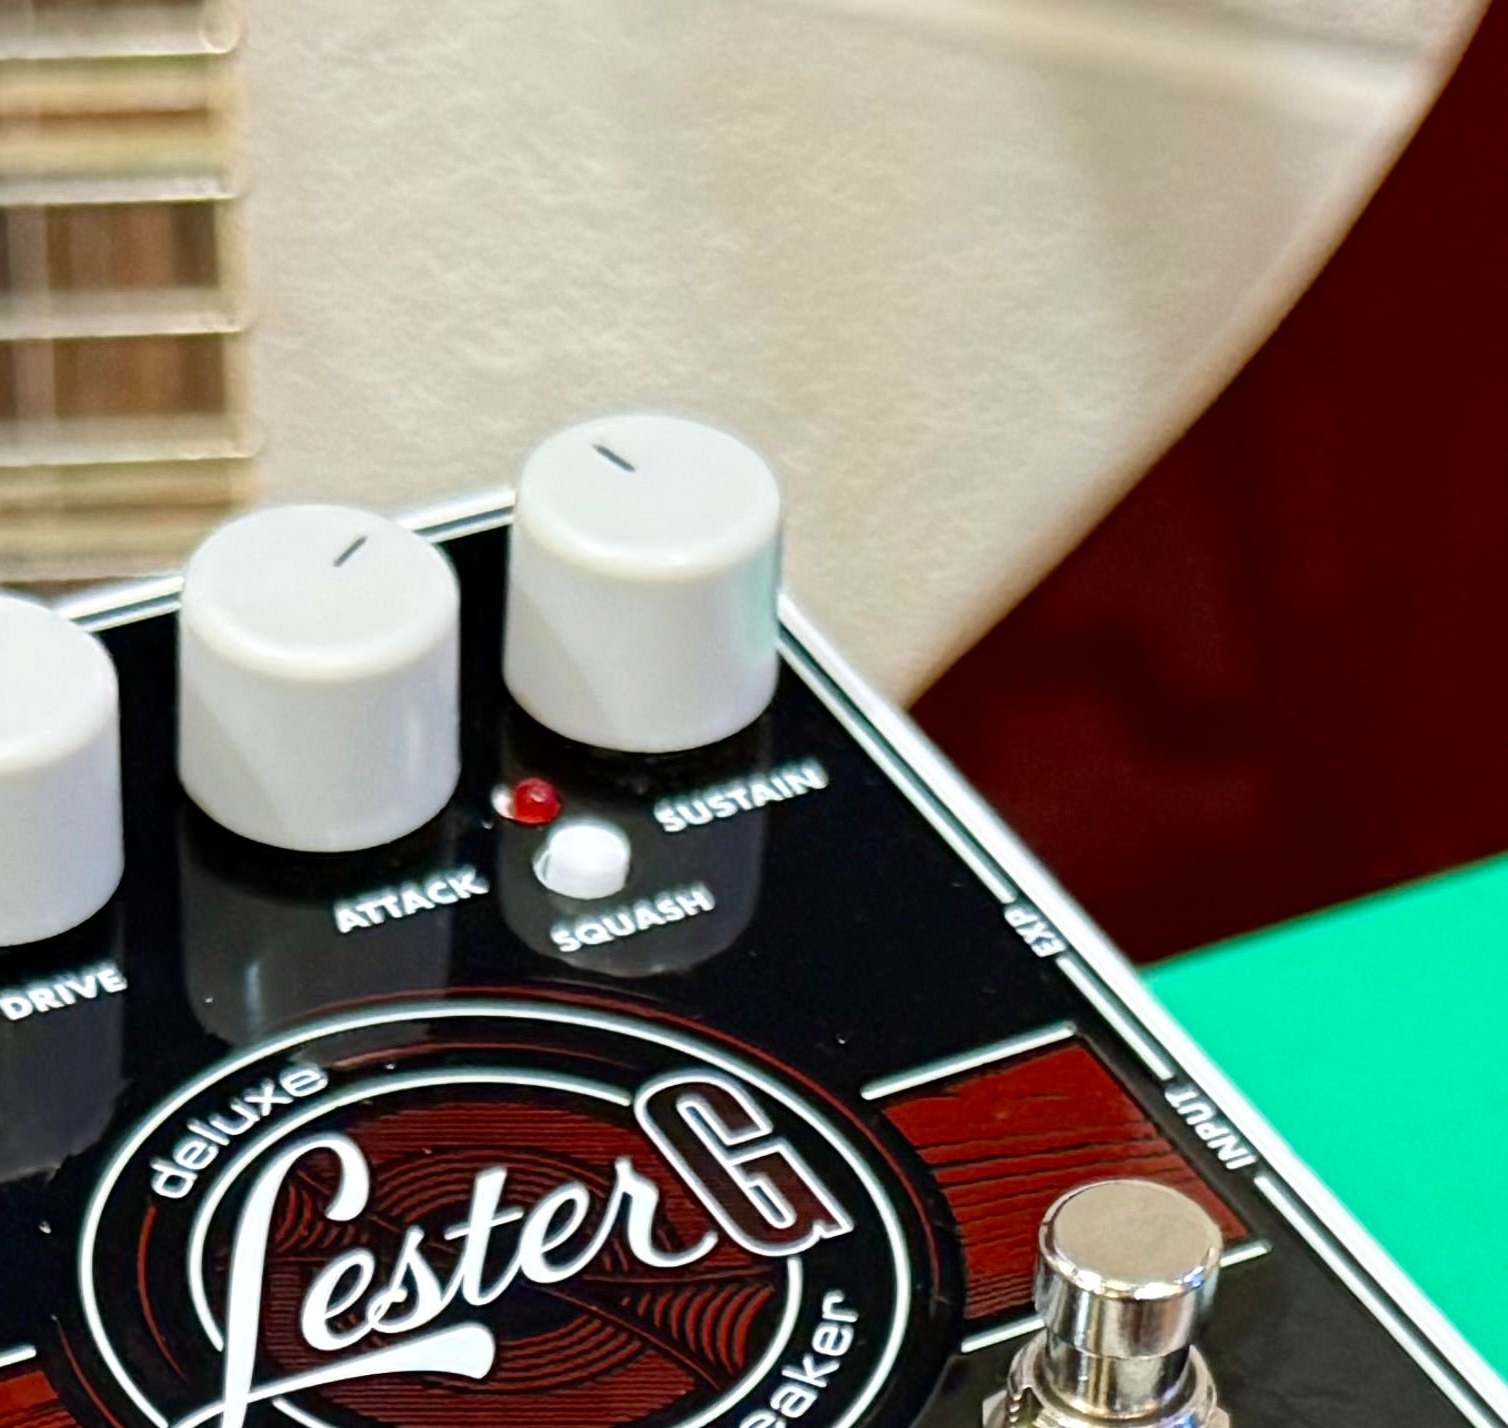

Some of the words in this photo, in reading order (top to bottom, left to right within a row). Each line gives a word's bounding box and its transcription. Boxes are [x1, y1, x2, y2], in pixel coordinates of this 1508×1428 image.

[653, 760, 829, 833] SUSTAIN
[333, 867, 489, 935] ATTACK
[549, 882, 716, 954] SQUASH
[1002, 902, 1066, 960] EXP
[150, 1060, 330, 1201] deluxe
[1163, 1082, 1257, 1172] INPUT
[634, 1070, 856, 1258] G
